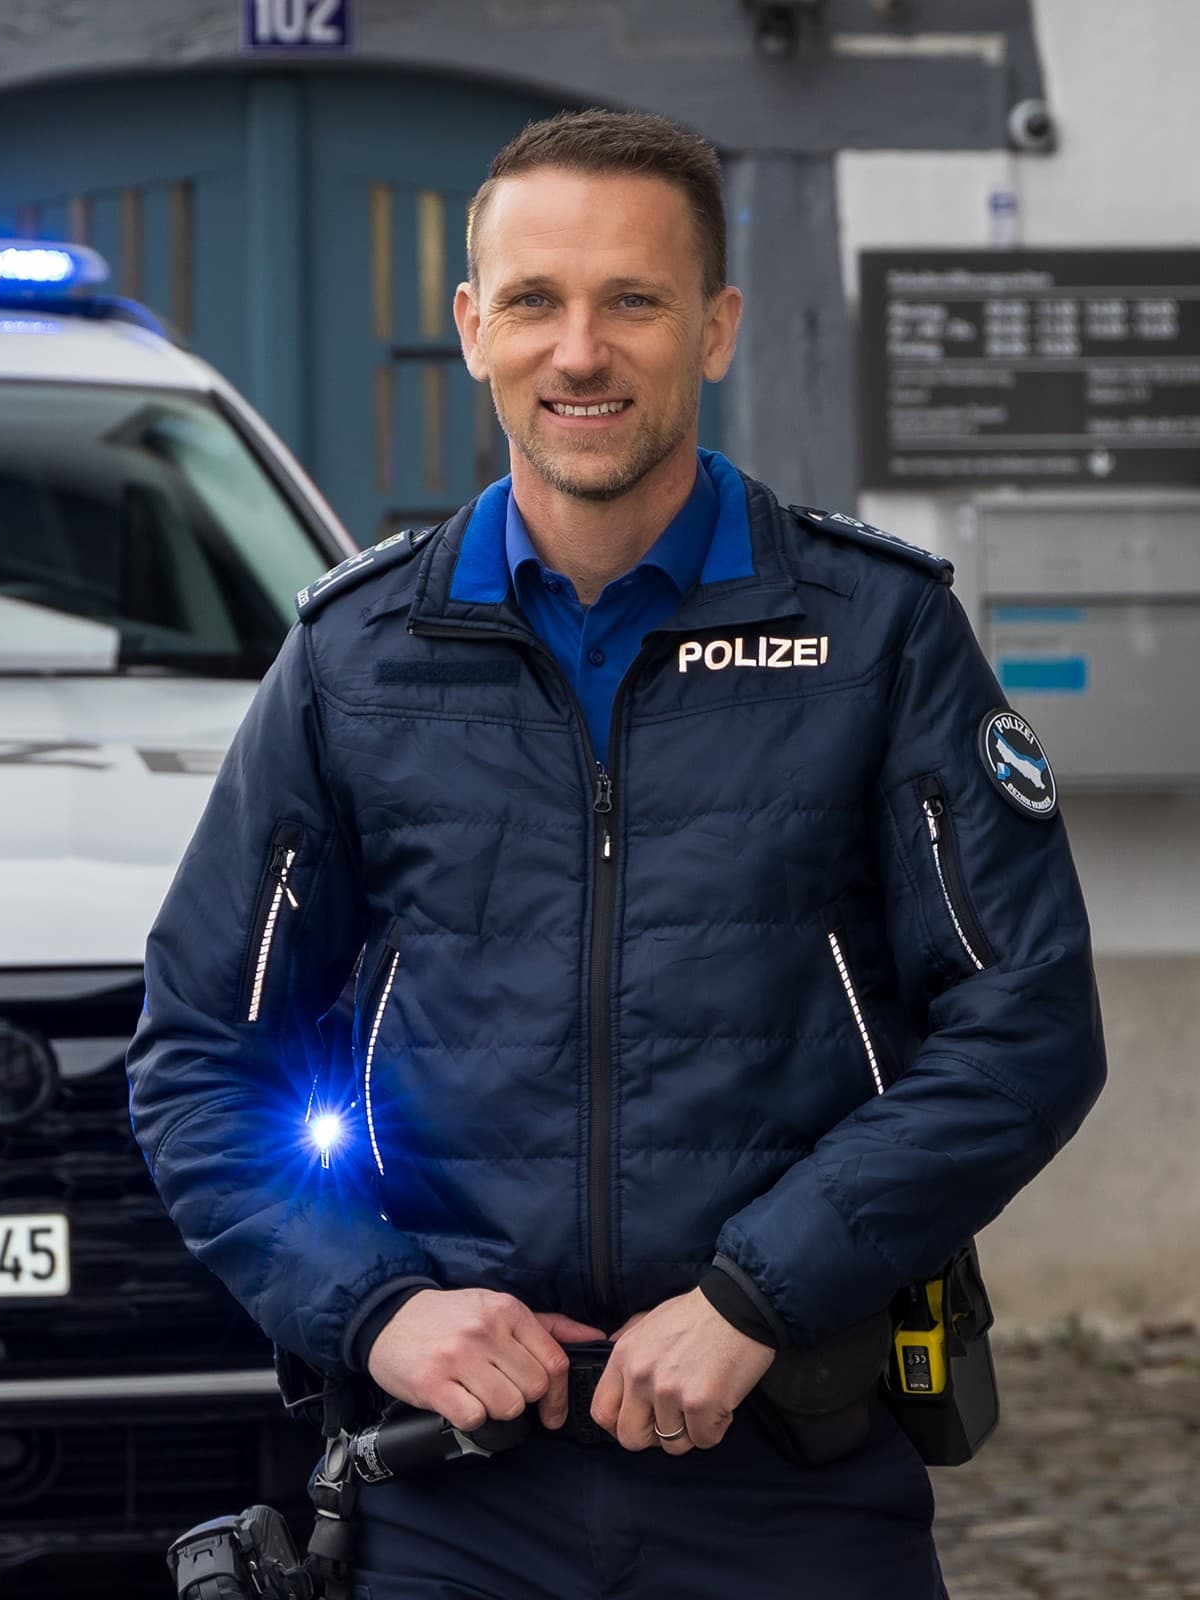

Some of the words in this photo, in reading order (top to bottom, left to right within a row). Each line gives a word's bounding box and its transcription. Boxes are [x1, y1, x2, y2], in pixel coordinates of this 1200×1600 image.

[255, 0, 341, 42] 102
[678, 636, 829, 673] POLIZEI
[995, 717, 1034, 744] POLIZEI
